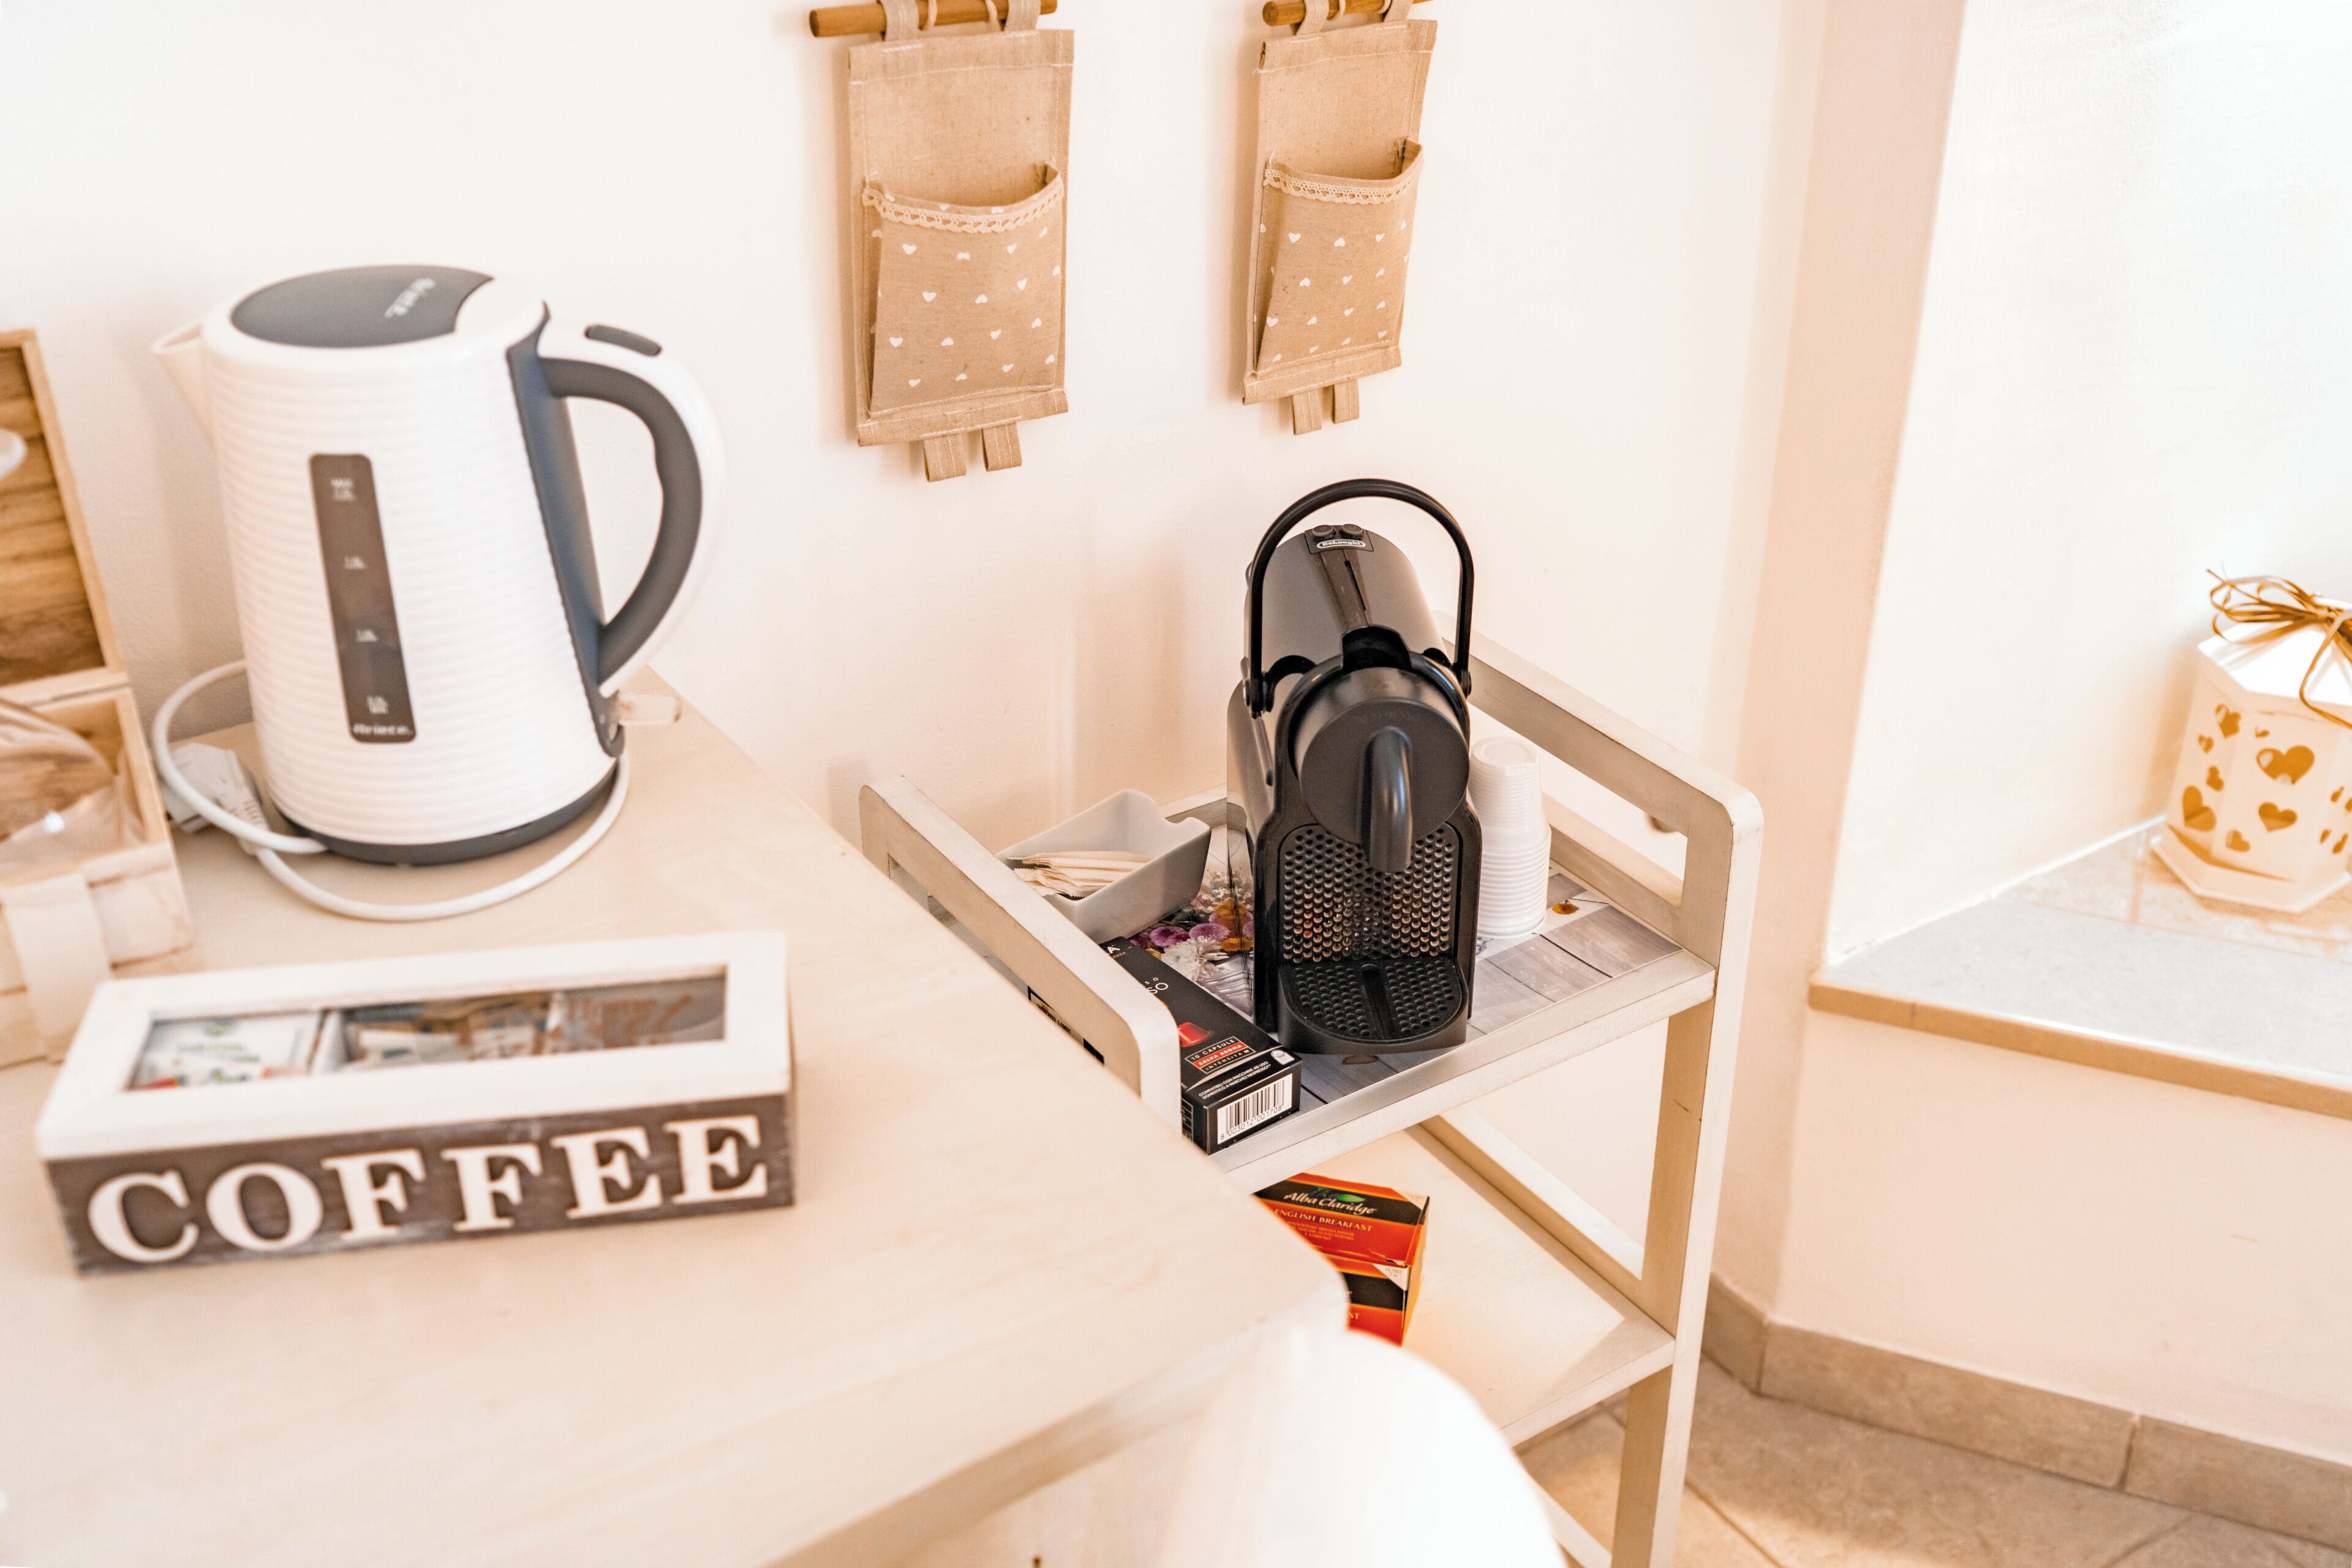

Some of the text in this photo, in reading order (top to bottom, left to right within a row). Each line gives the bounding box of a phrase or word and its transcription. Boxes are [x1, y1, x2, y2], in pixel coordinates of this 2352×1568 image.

[1198, 1044, 1243, 1065] SALVA AROMA
[1202, 1039, 1235, 1055] CAPSULE
[88, 1115, 768, 1264] COFFEE
[1284, 1193, 1317, 1204] Alba
[1274, 1208, 1316, 1221] ENGLISH
[1319, 1216, 1373, 1232] BREAKFAST
